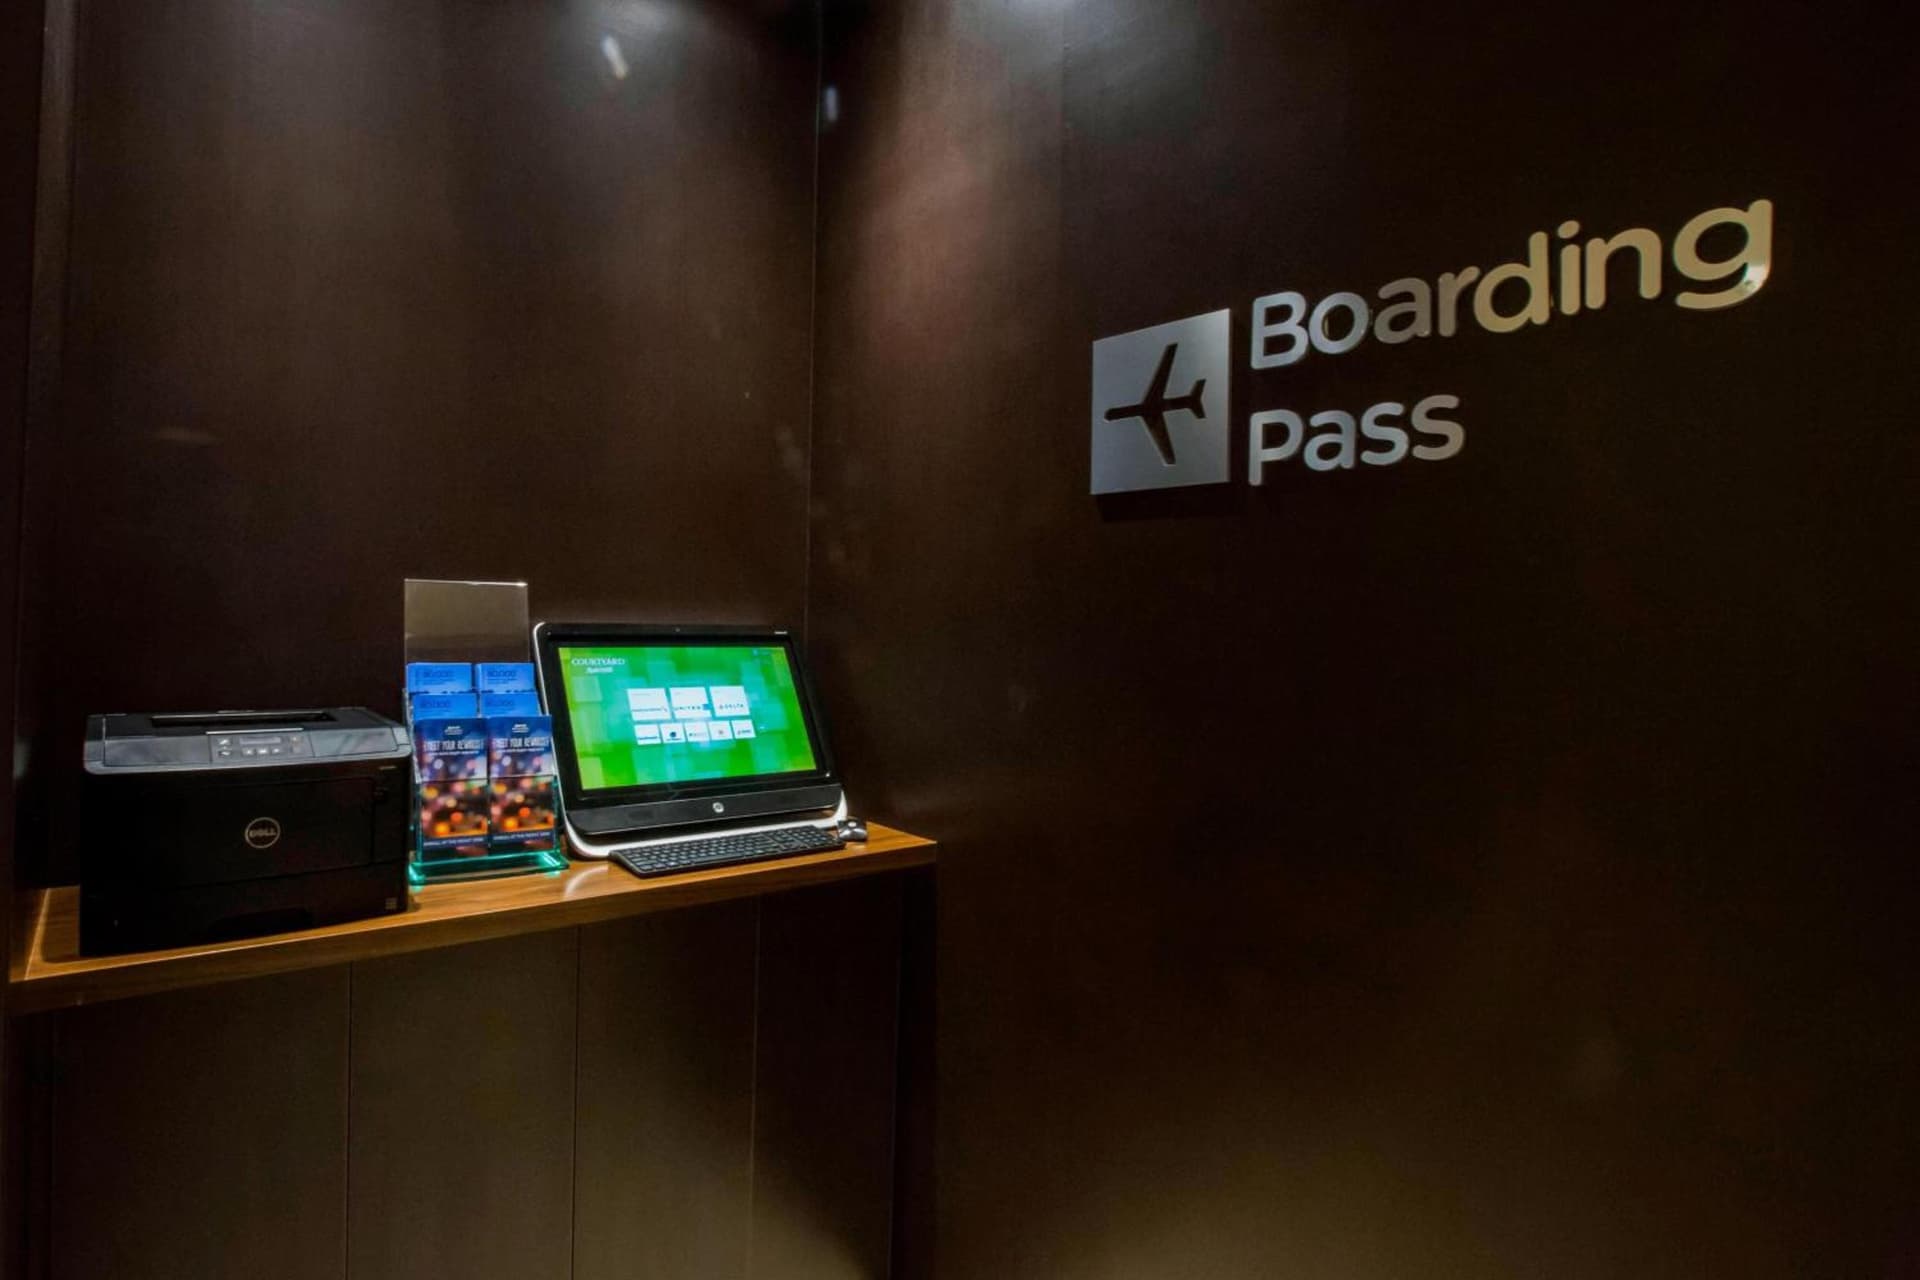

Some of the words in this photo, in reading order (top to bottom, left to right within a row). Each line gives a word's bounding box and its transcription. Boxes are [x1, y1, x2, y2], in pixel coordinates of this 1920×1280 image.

[1250, 199, 1773, 369] Boarding
[1248, 393, 1465, 486] pass
[249, 828, 276, 839] DELL
